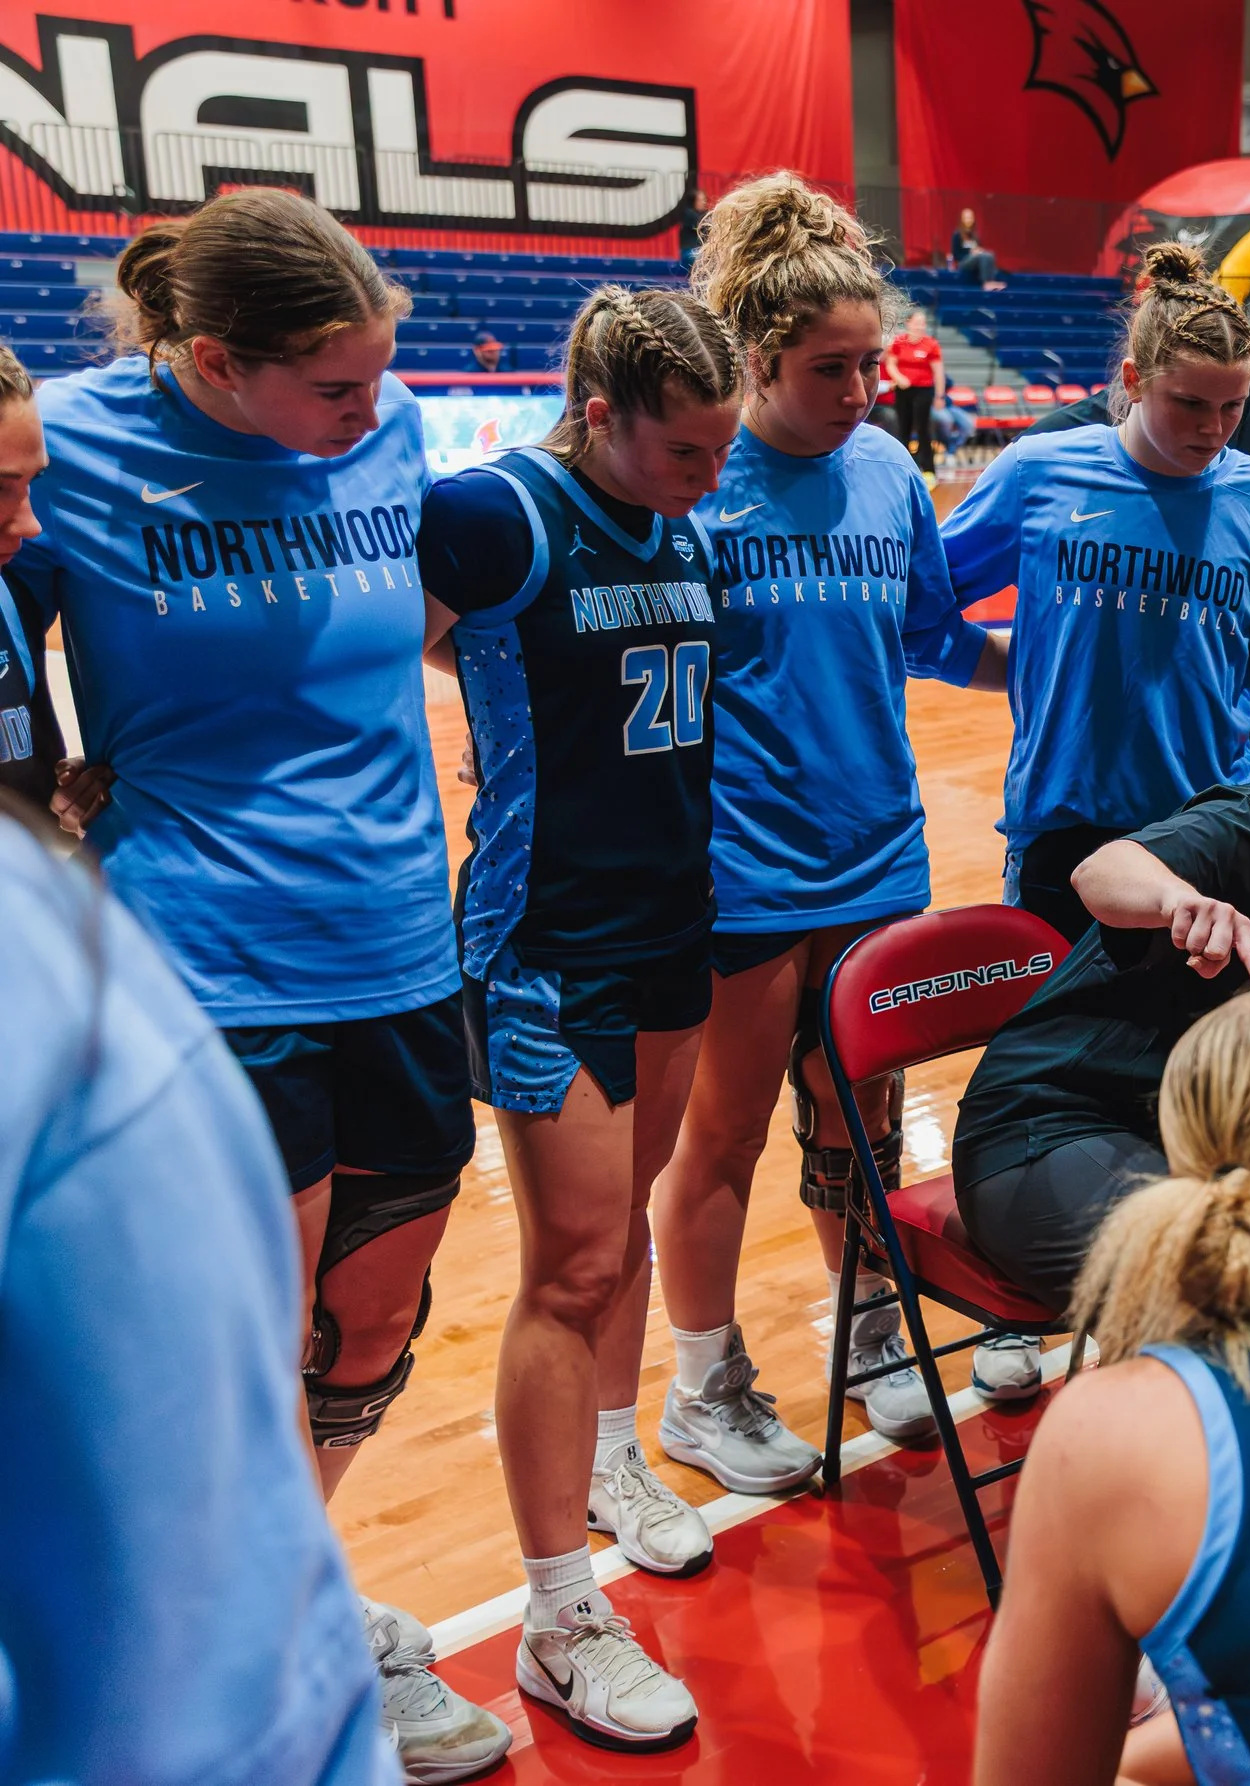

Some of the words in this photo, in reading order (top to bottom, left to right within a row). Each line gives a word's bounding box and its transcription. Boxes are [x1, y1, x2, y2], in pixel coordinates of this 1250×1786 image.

[141, 504, 415, 584] NORTHWOOD
[716, 534, 907, 583] NORTHWOOD
[1057, 539, 1245, 613] NORTHWOOD
[621, 640, 710, 756] 20
[869, 952, 1053, 1014] CARDINALS
